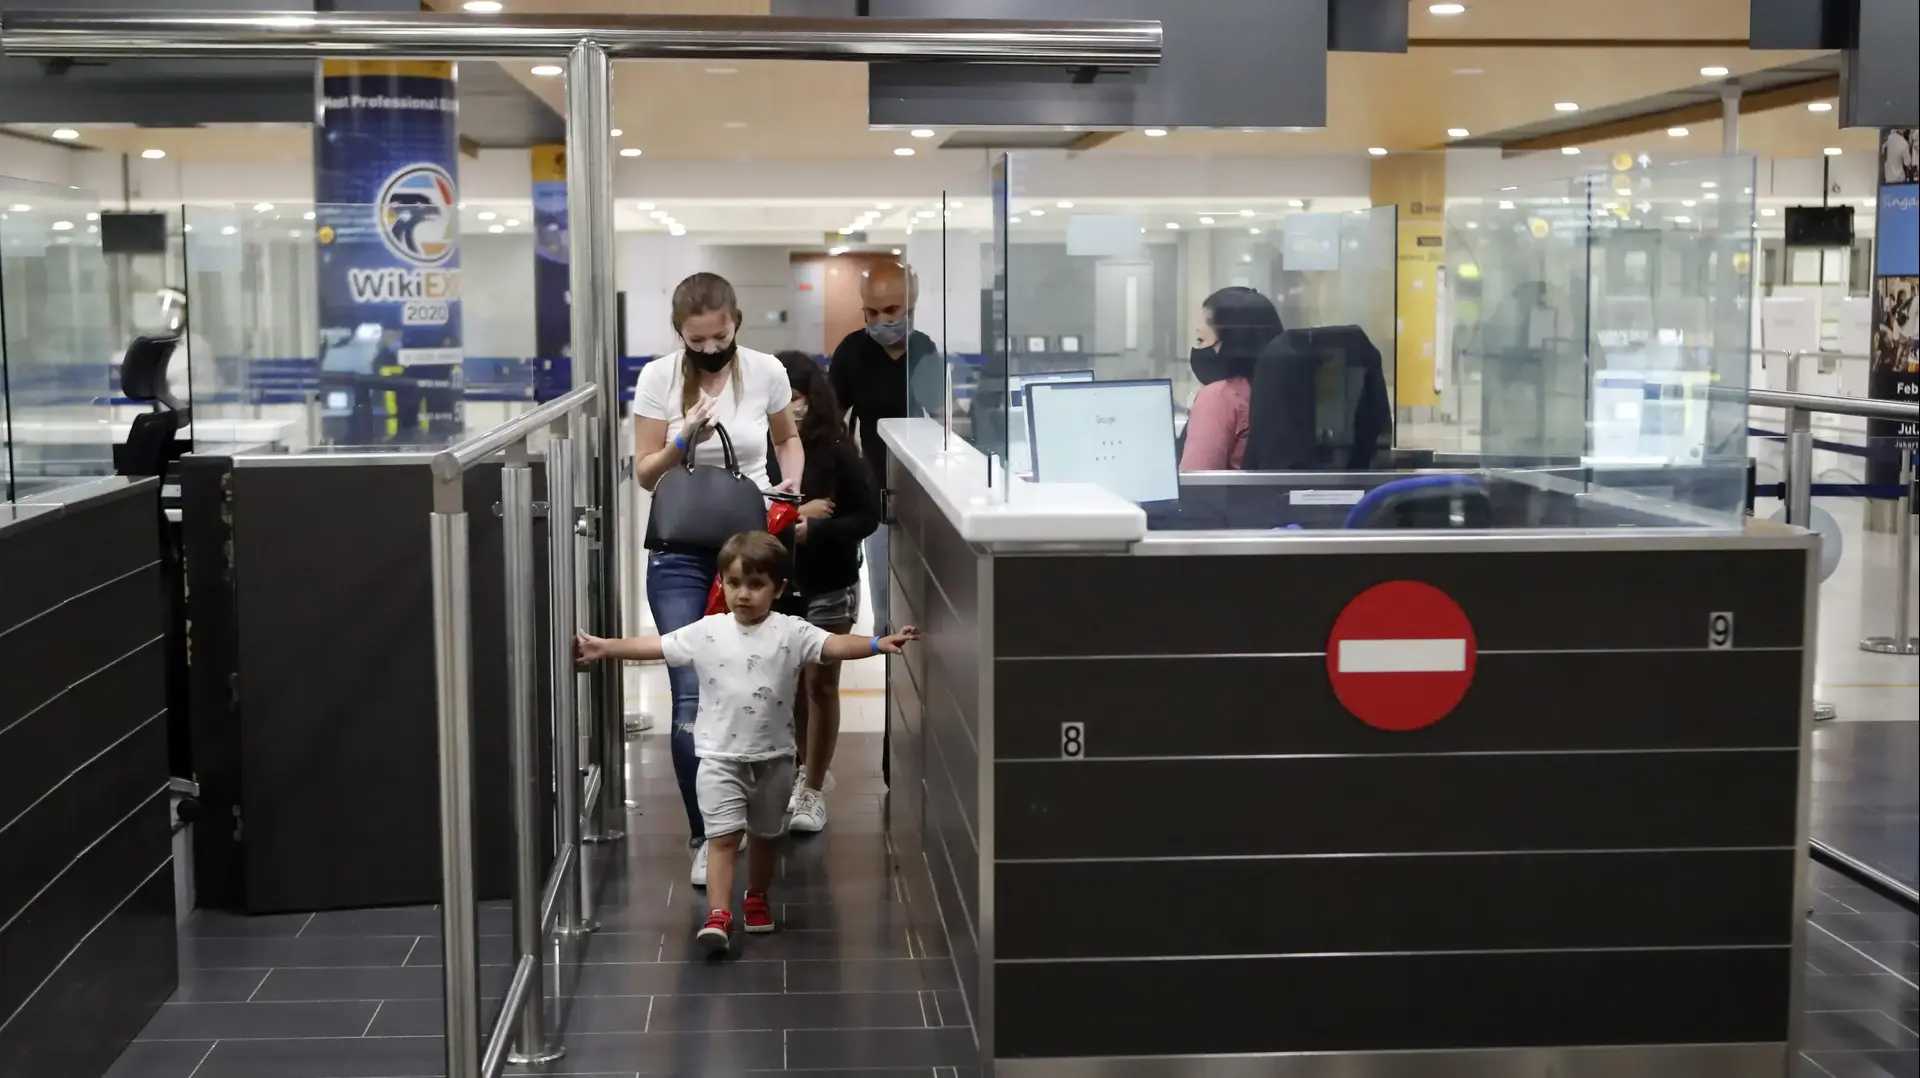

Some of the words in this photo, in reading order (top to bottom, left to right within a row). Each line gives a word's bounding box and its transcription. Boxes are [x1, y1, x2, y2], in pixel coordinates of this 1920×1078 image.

[351, 95, 438, 110] Professional
[407, 306, 448, 321] 2020
[1711, 615, 1730, 646] 9
[1064, 726, 1081, 757] 8
